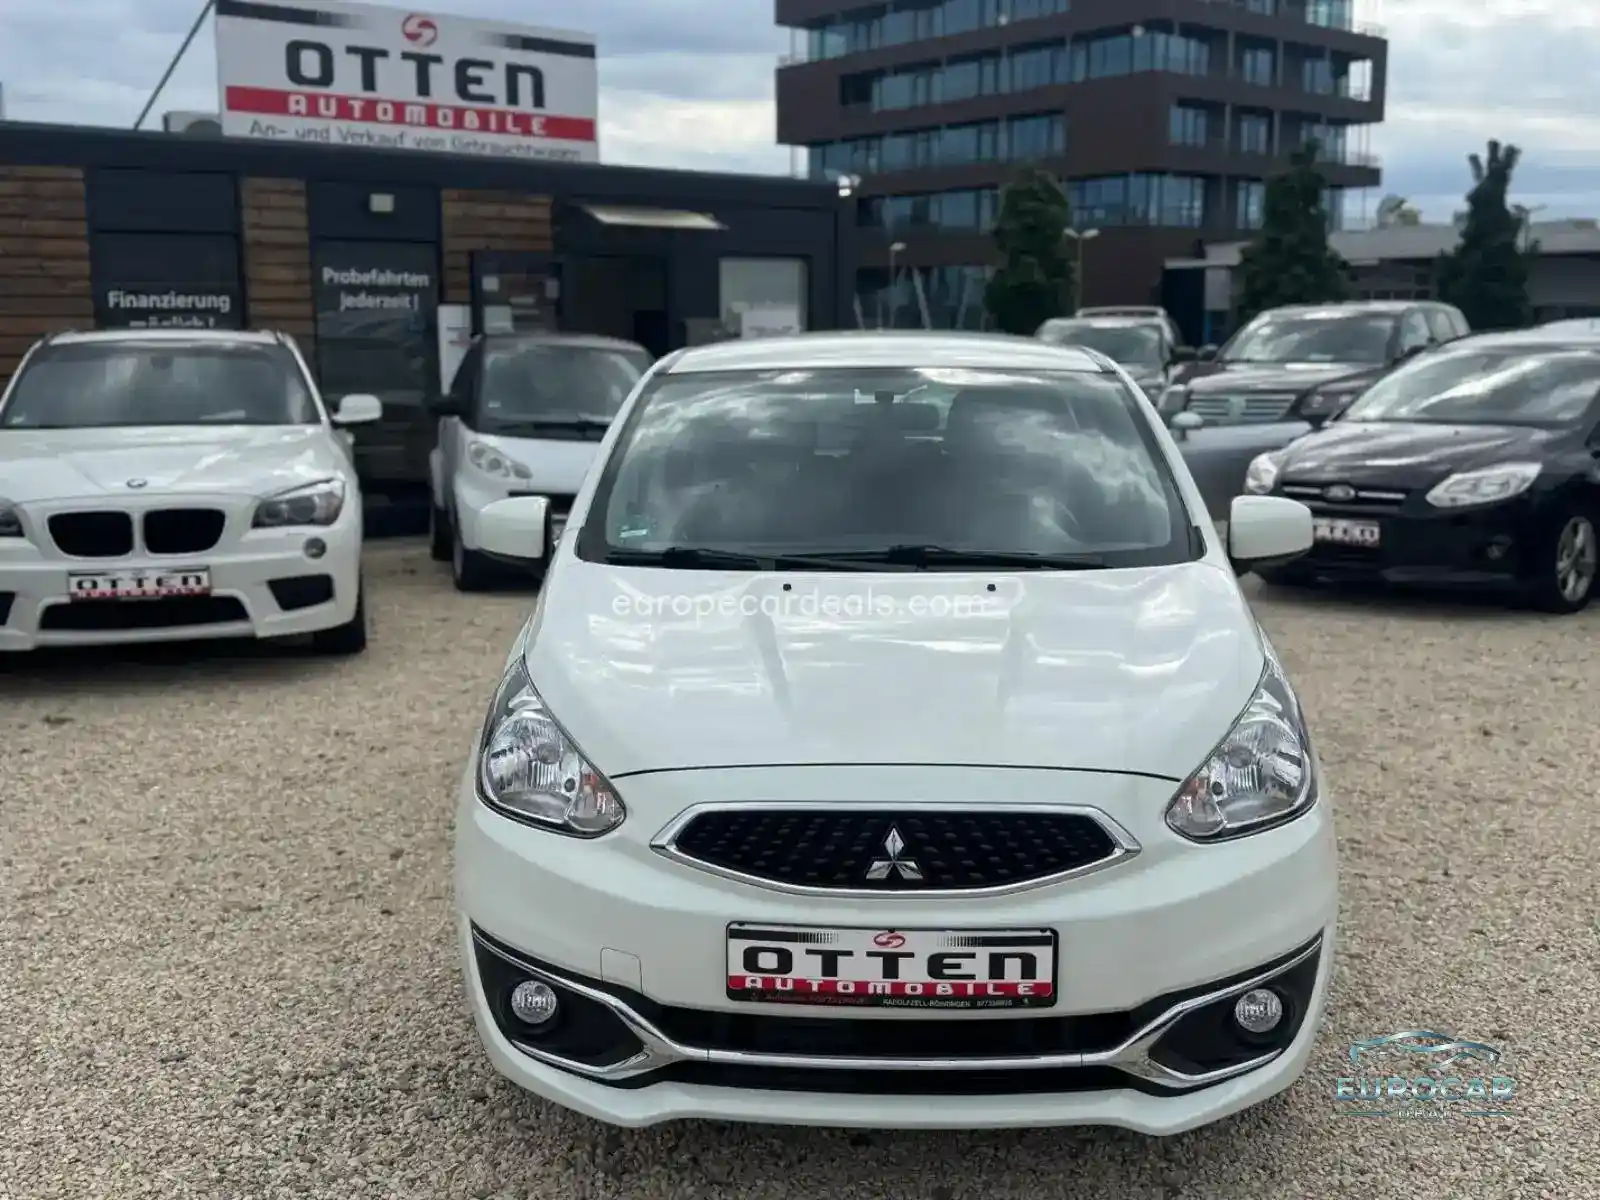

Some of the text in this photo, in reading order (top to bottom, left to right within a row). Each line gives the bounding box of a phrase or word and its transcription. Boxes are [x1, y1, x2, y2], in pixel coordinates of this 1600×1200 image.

[285, 39, 546, 109] OTTEN
[288, 93, 549, 136] AUTOMOBILE
[249, 119, 287, 137] An-
[295, 124, 331, 144] und
[337, 126, 406, 147] Verkauf
[322, 266, 430, 287] Probefahrten
[108, 288, 231, 313] Finanzierung
[76, 574, 203, 590] OTTEN
[742, 945, 1038, 980] OTTEN
[744, 977, 1036, 996] AUTOMOBILE
